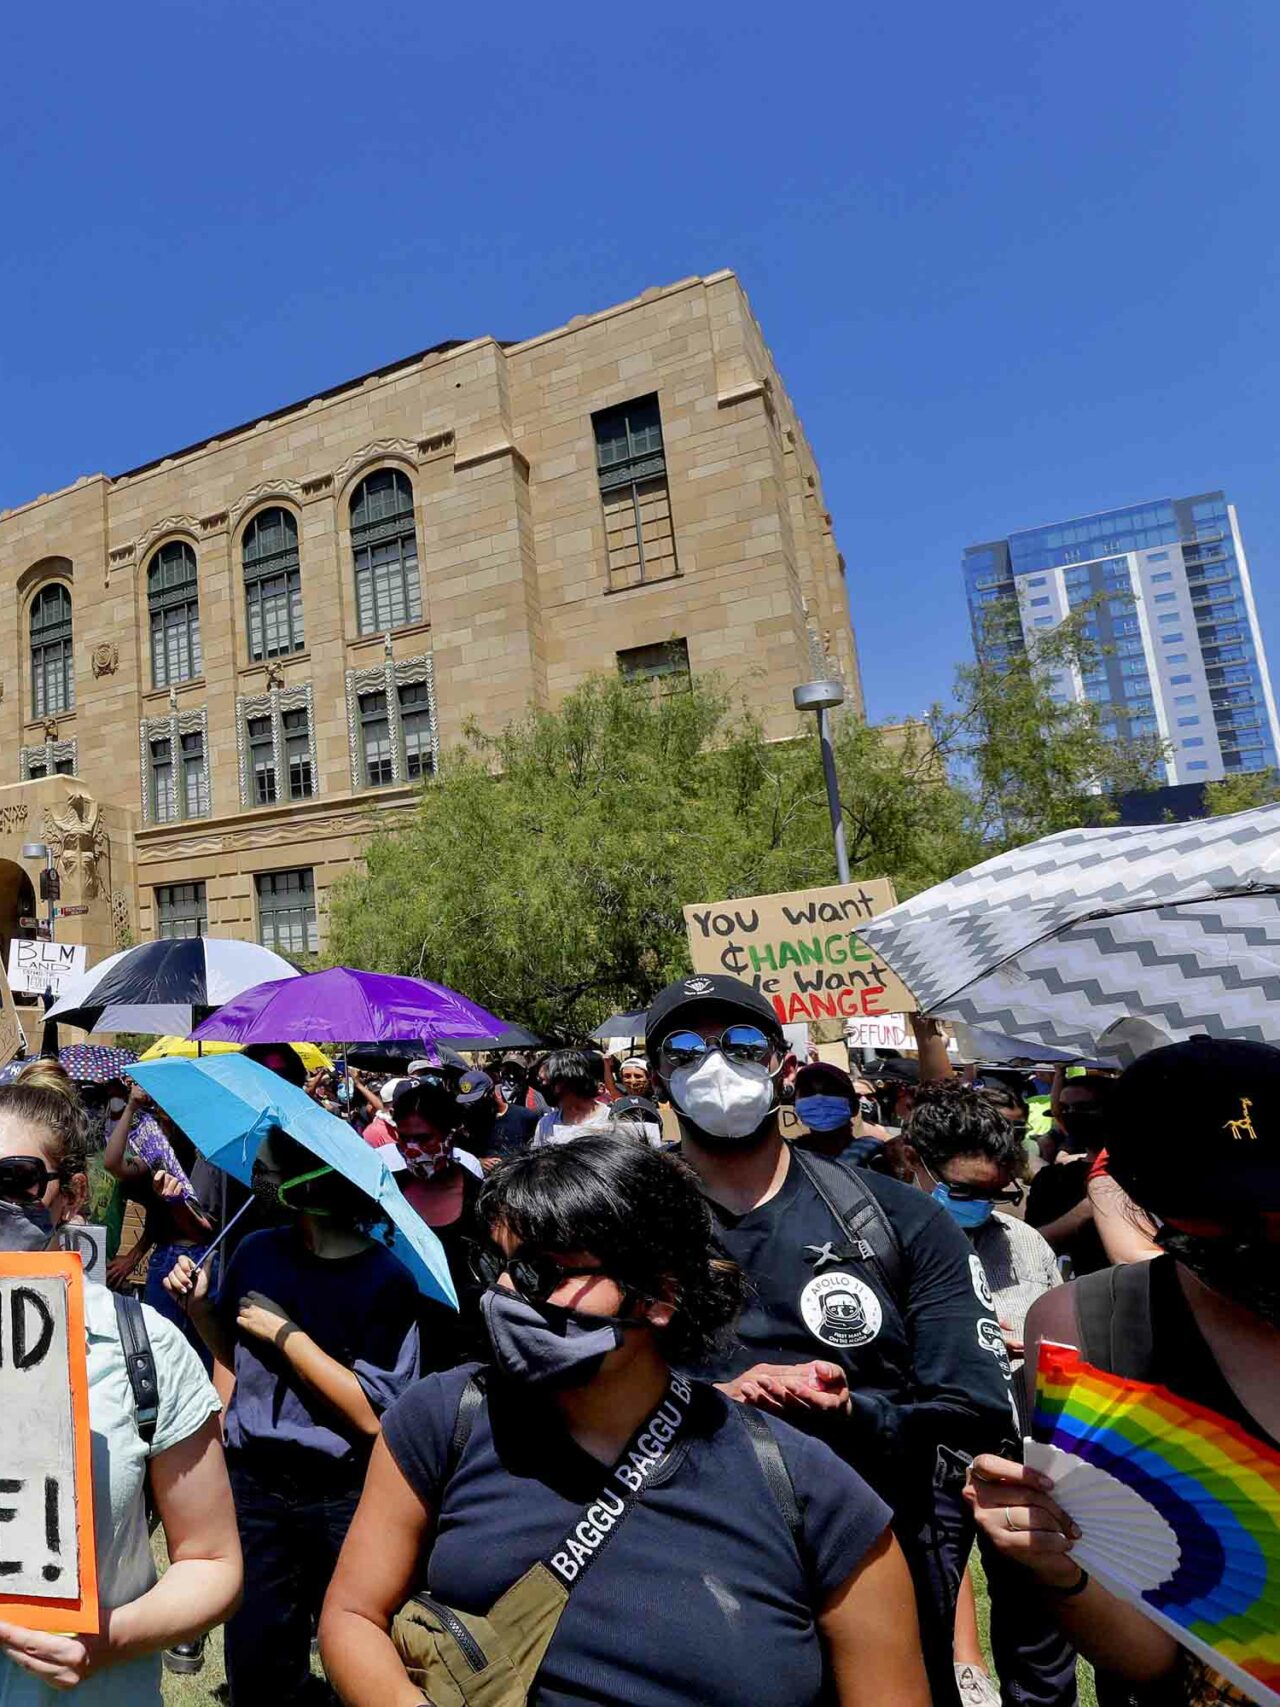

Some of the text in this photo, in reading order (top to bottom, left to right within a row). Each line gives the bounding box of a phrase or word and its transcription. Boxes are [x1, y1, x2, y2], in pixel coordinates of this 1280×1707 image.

[17, 940, 75, 963] BLM
[811, 1276, 850, 1296] APOLLO
[550, 1487, 625, 1582] BAGGU
[614, 1400, 682, 1492] BAGGU
